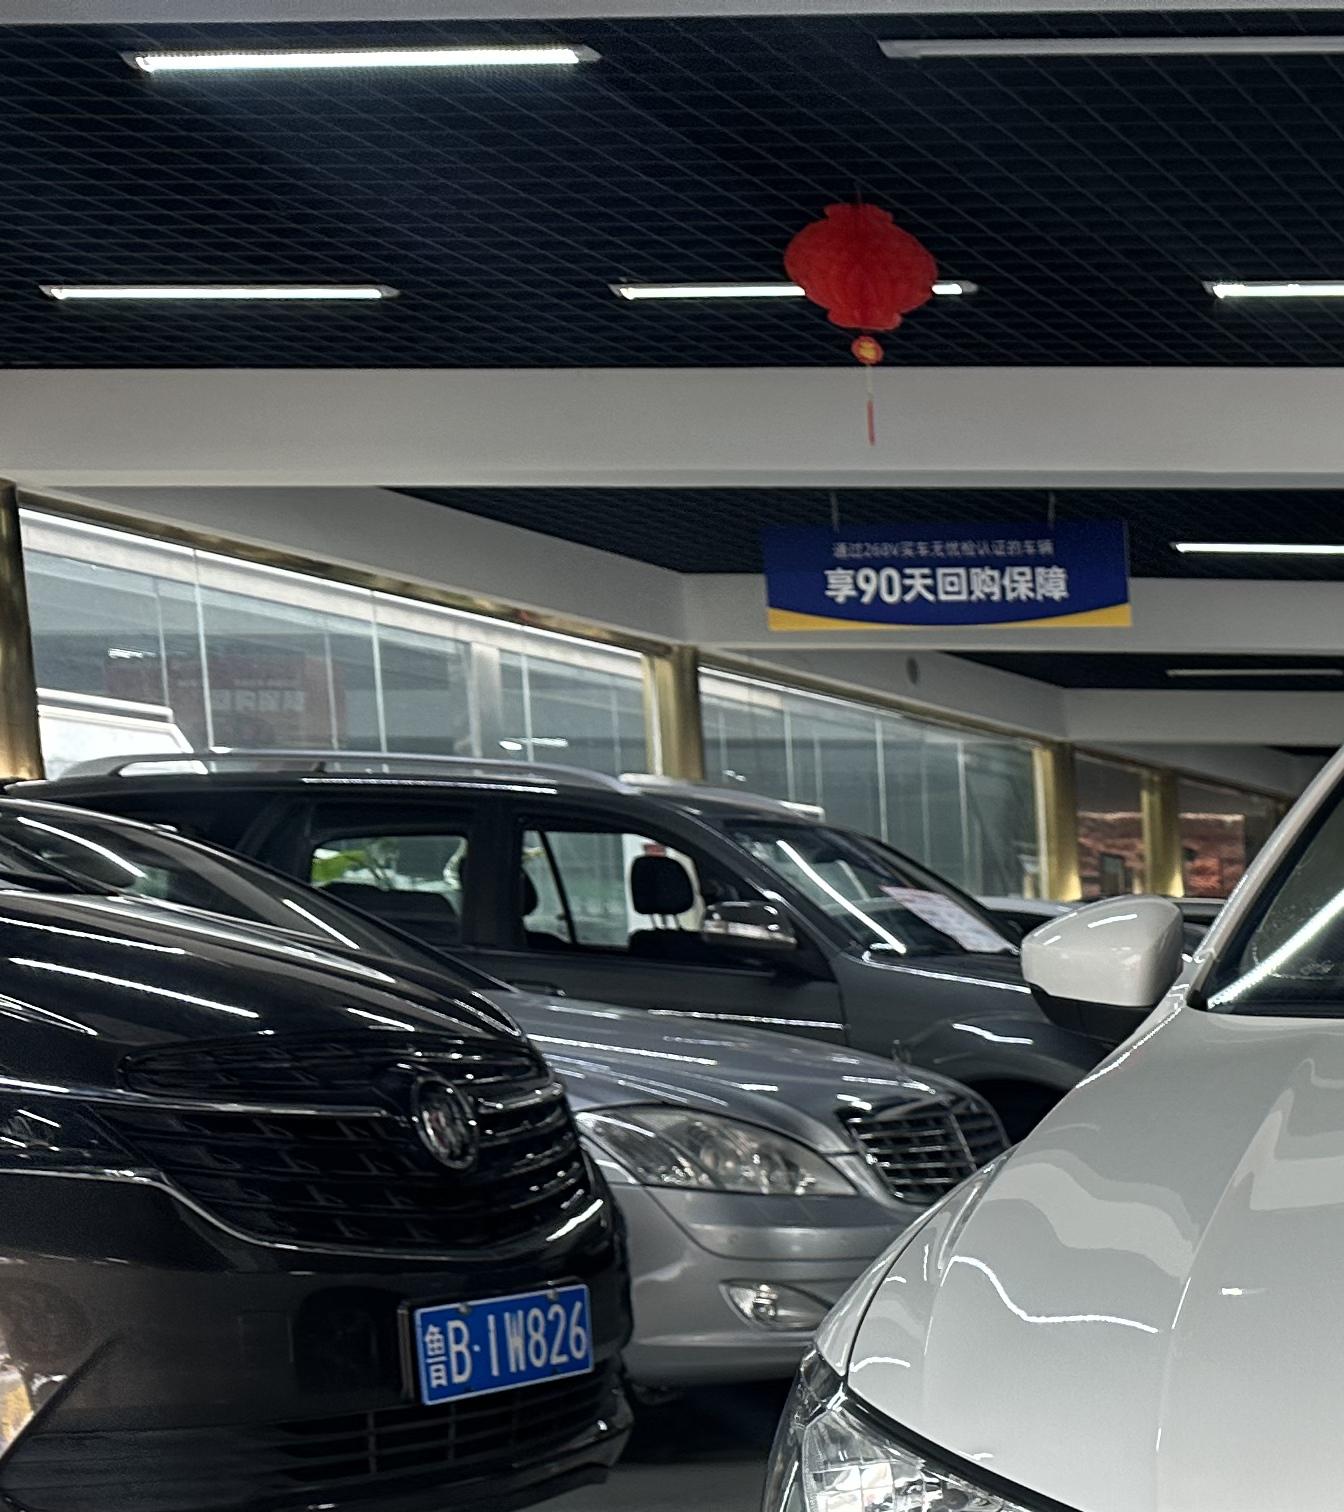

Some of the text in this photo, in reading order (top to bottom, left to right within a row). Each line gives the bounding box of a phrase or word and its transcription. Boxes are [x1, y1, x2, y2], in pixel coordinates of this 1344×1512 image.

[824, 566, 1068, 604] 享90天回购保障
